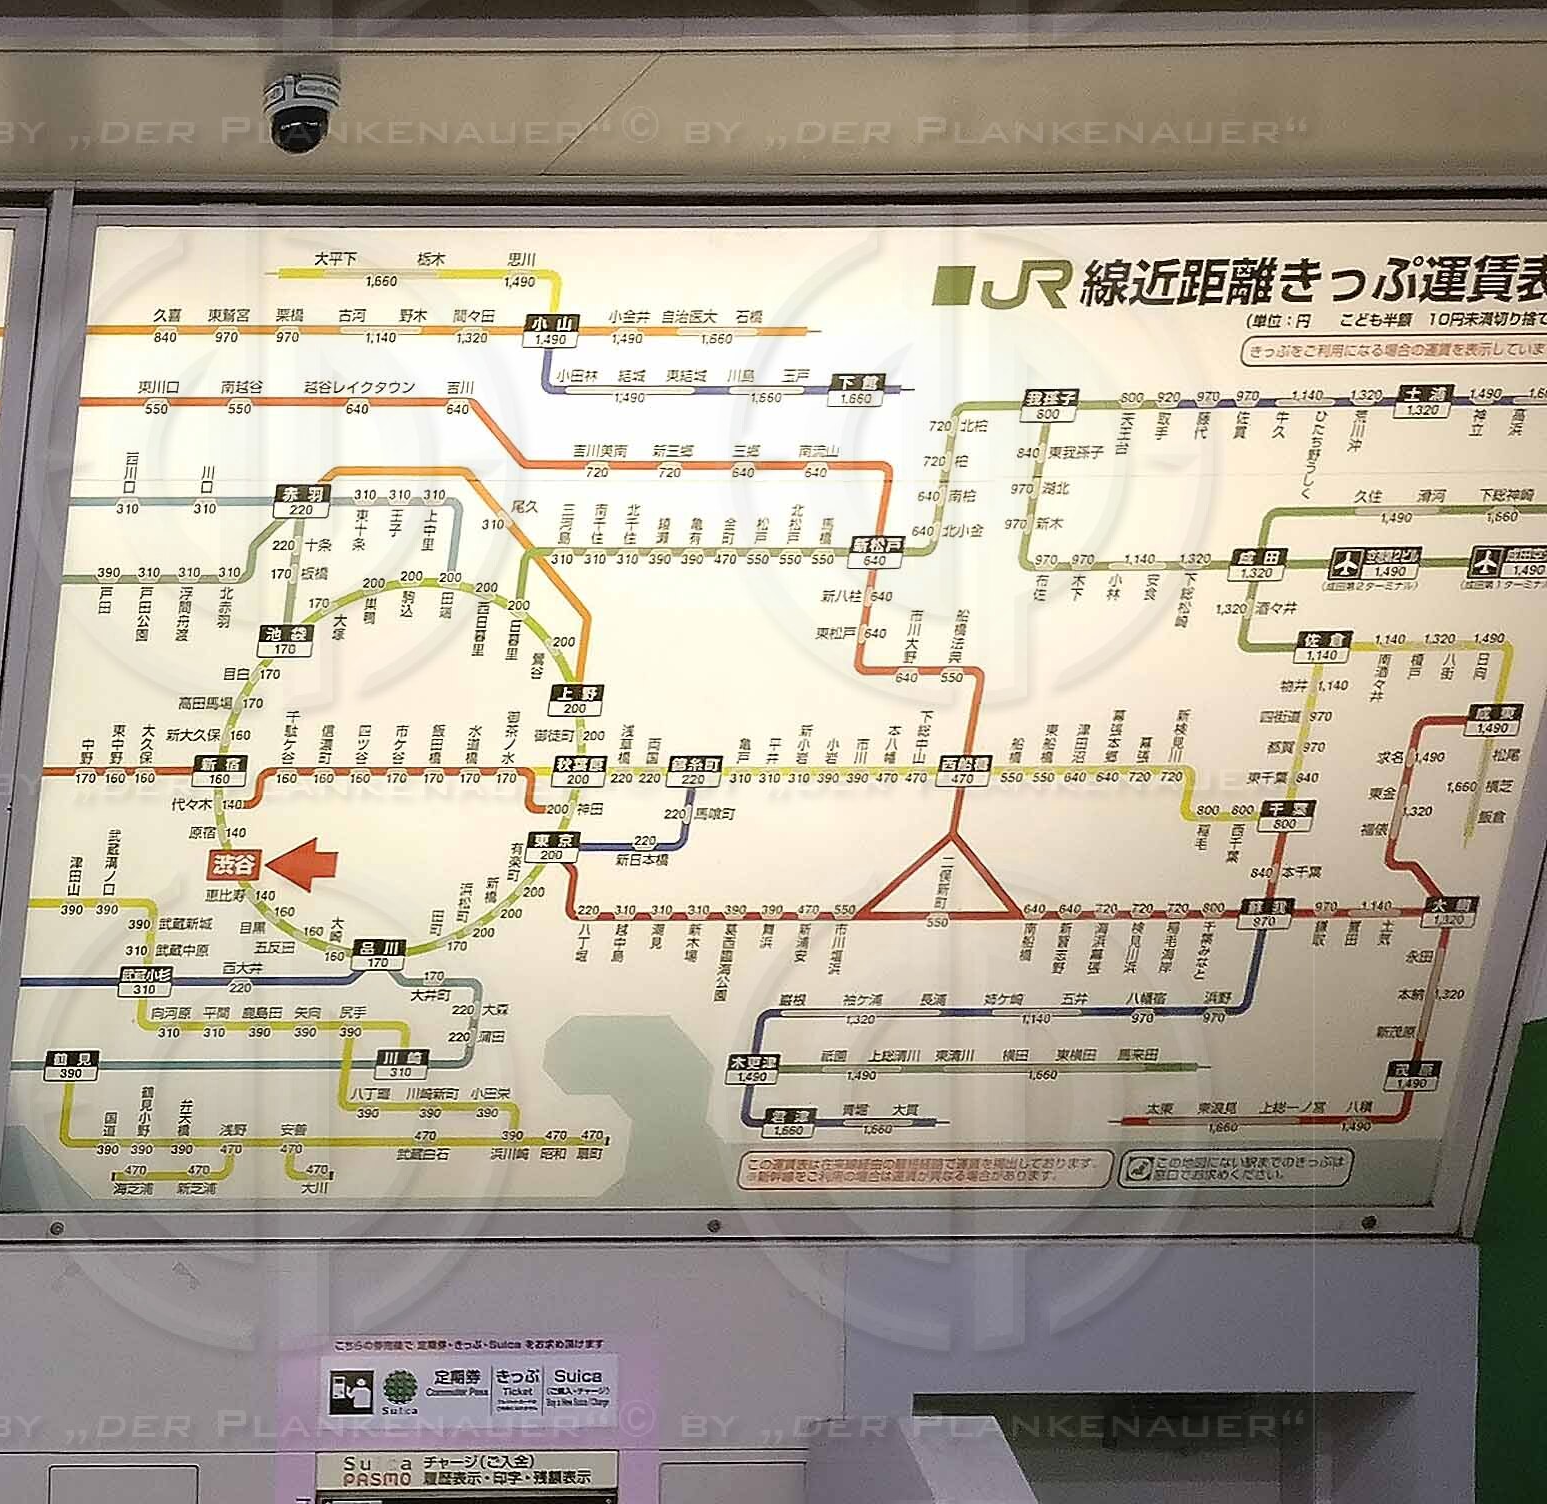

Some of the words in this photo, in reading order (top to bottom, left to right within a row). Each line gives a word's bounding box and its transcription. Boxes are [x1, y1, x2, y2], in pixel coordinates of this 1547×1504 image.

[314, 251, 358, 267] 大平下
[417, 251, 446, 267] 栃木
[981, 259, 1075, 310] JR
[153, 308, 182, 323] 久喜
[1340, 312, 1413, 328] こども半額
[531, 316, 573, 332] 小山
[138, 380, 180, 395] 東川口
[221, 379, 263, 395] 南越谷
[303, 379, 416, 396] 越谷レイクタウン
[202, 756, 239, 772] 新宿
[171, 797, 212, 812] 代々木
[213, 852, 256, 877] 渋谷
[615, 852, 669, 868] 新日本橋
